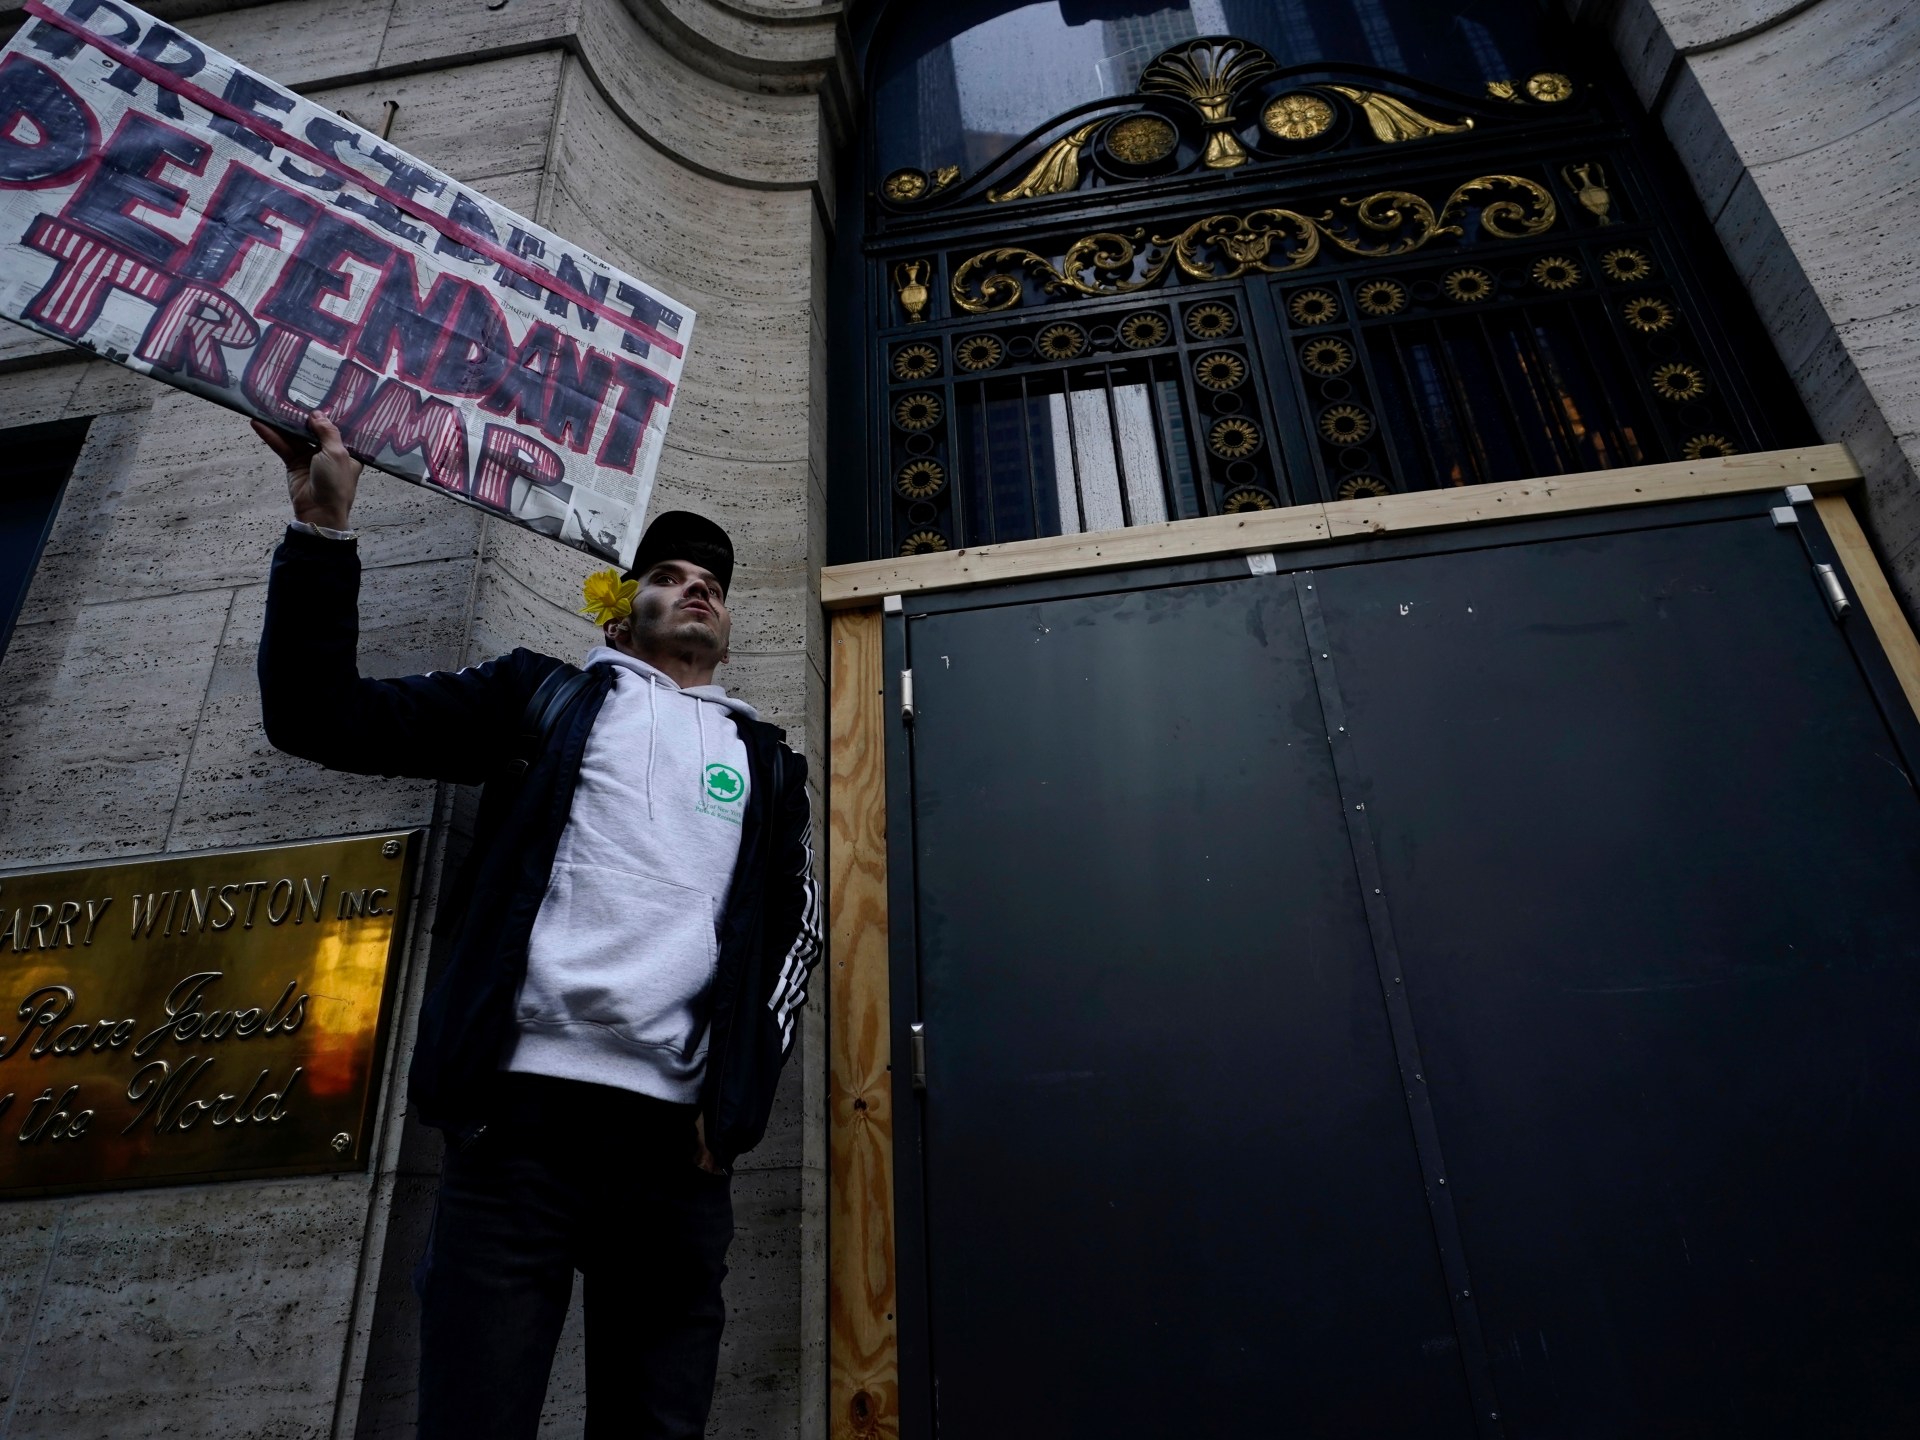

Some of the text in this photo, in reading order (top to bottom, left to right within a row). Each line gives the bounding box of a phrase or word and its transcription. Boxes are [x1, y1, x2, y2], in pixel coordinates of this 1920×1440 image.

[0, 51, 674, 474] DEFENDANT
[27, 0, 683, 359] PRESIDENT
[20, 212, 565, 514] TRUMP
[0, 874, 394, 954] ARRY WINSTON INC.
[0, 971, 311, 1060] Rare Jewels
[17, 1055, 303, 1144] the World
